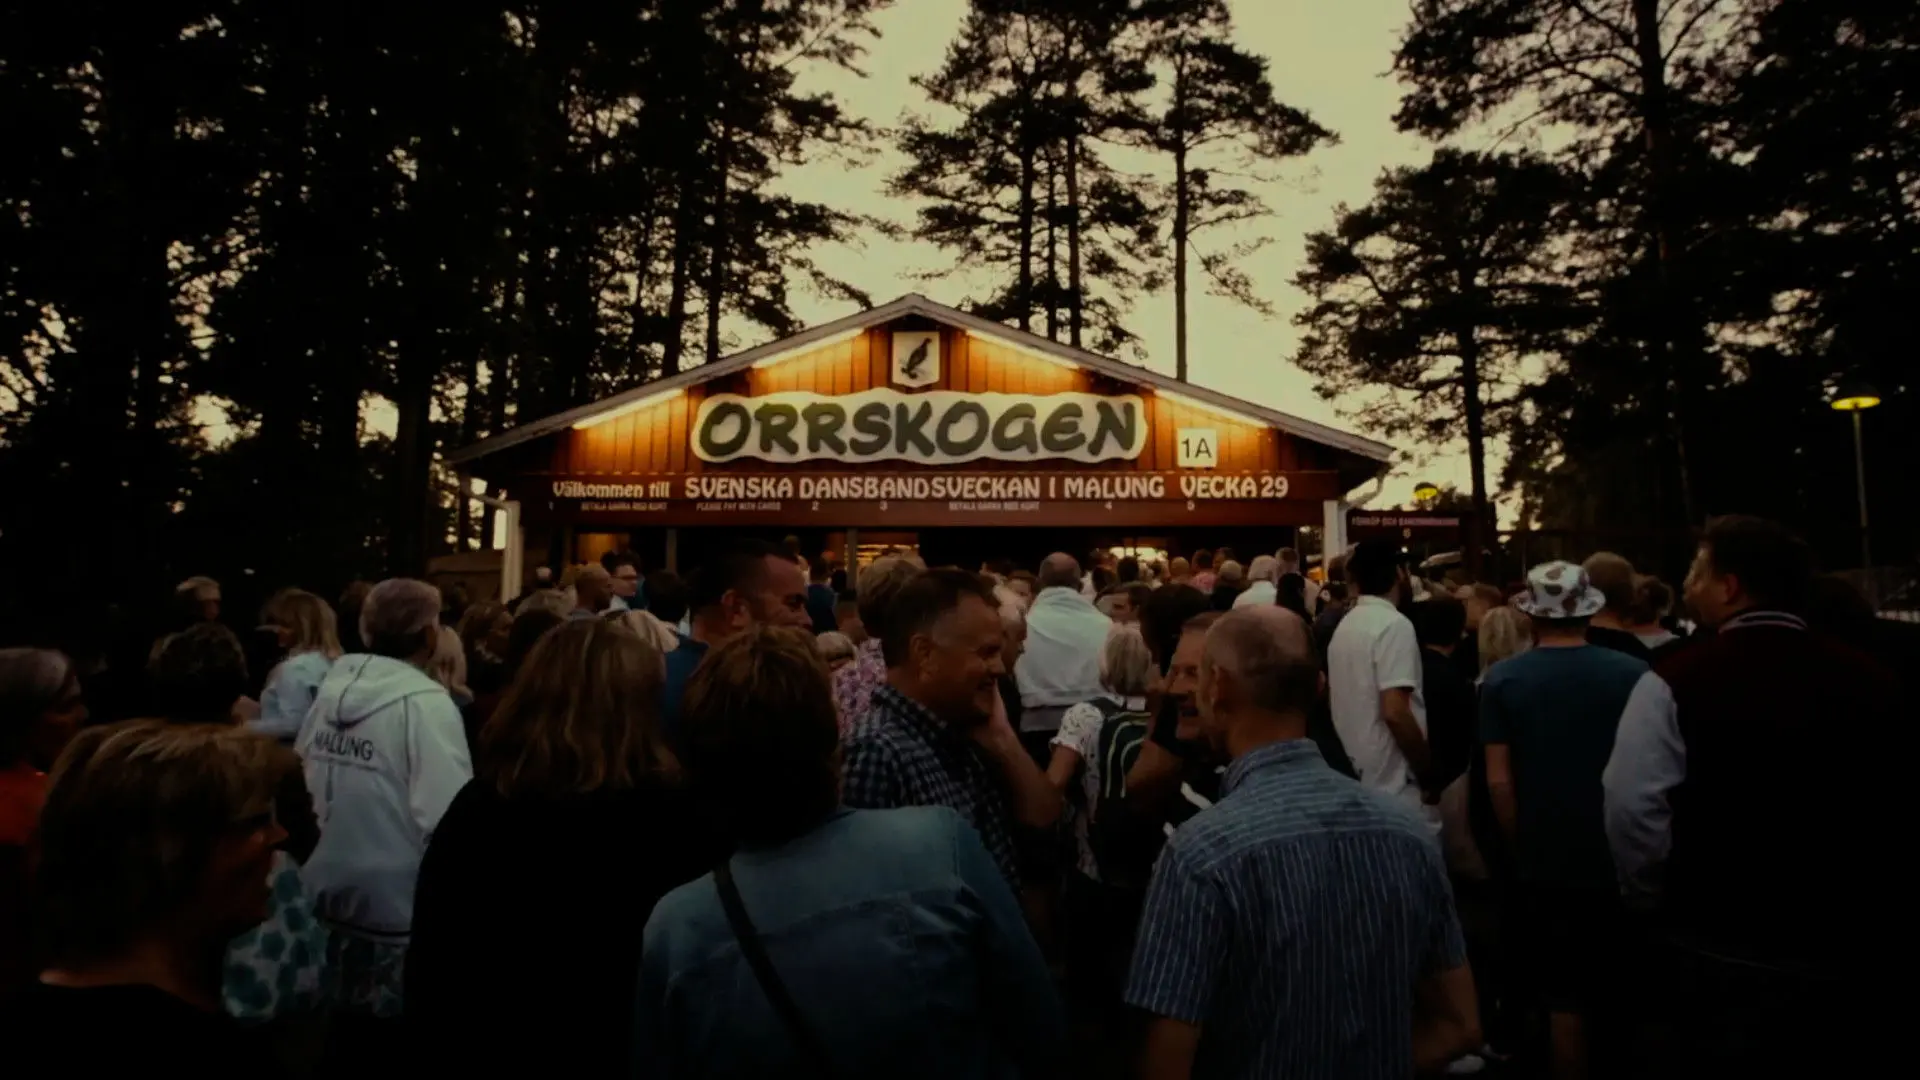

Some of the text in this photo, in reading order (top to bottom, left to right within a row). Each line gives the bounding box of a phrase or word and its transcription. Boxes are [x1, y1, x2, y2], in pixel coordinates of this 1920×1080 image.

[699, 401, 1138, 456] ORRSKOGEN
[1181, 437, 1213, 460] 1A
[552, 480, 644, 498] Välkommen
[648, 481, 670, 498] till
[684, 476, 794, 499] SVENSKA
[1049, 476, 1056, 498] I
[1064, 476, 1165, 499] MALUNG
[1179, 476, 1257, 499] VECKA
[1260, 476, 1289, 498] 29
